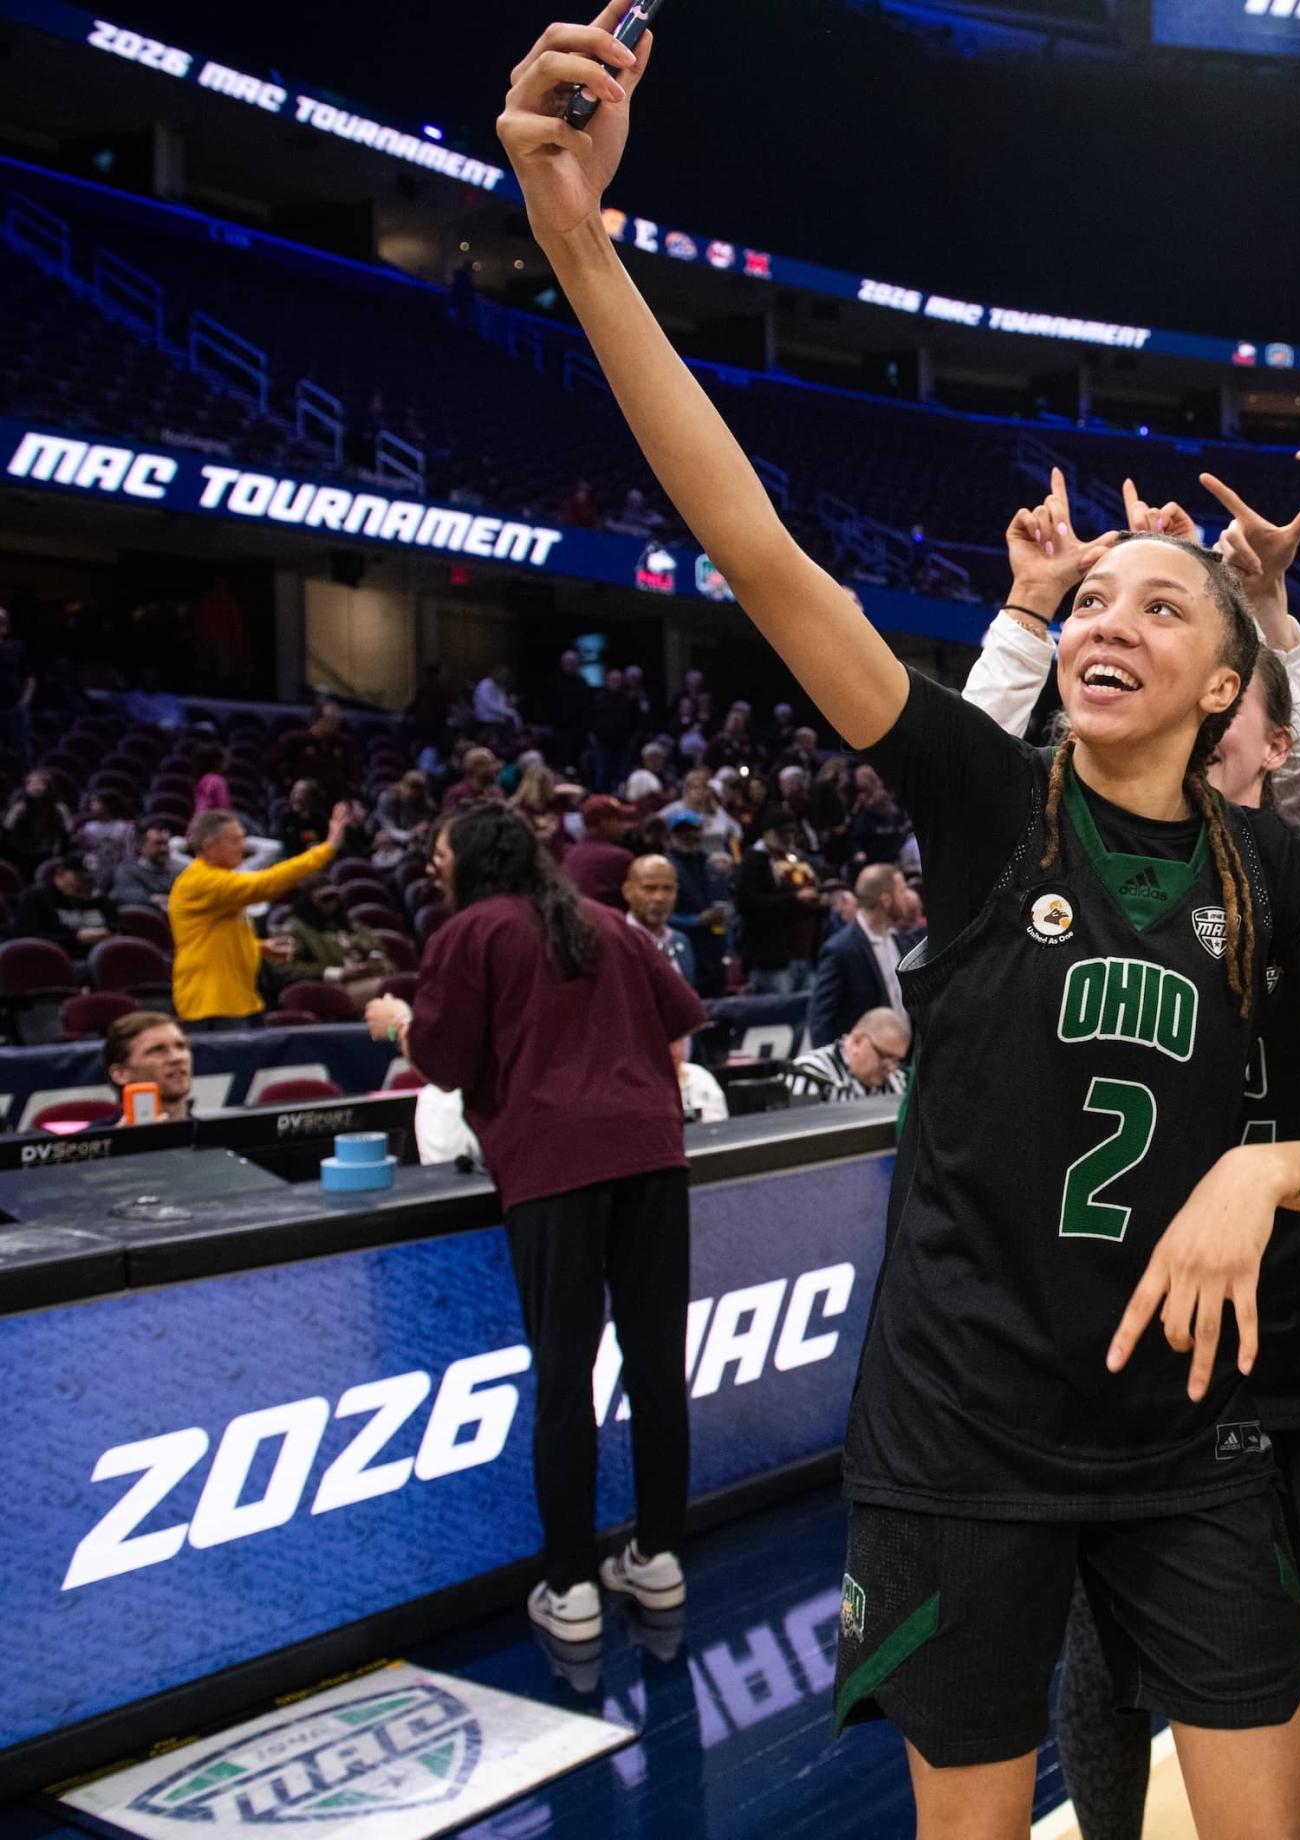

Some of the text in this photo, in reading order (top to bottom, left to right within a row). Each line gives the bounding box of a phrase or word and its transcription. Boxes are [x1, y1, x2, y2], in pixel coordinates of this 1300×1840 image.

[87, 20, 503, 190] 2026 MAC TOURNAMENT
[857, 279, 1151, 349] 2026 MAC TOURNAMENT
[7, 432, 562, 566] MAC TOURNAMENT
[1026, 926, 1048, 944] United
[1059, 930, 1074, 942] One
[1119, 885, 1168, 901] adidas
[1196, 922, 1228, 938] MA
[1056, 956, 1199, 1063] OHIO
[1058, 1076, 1157, 1243] 2
[62, 1345, 532, 1592] 2026
